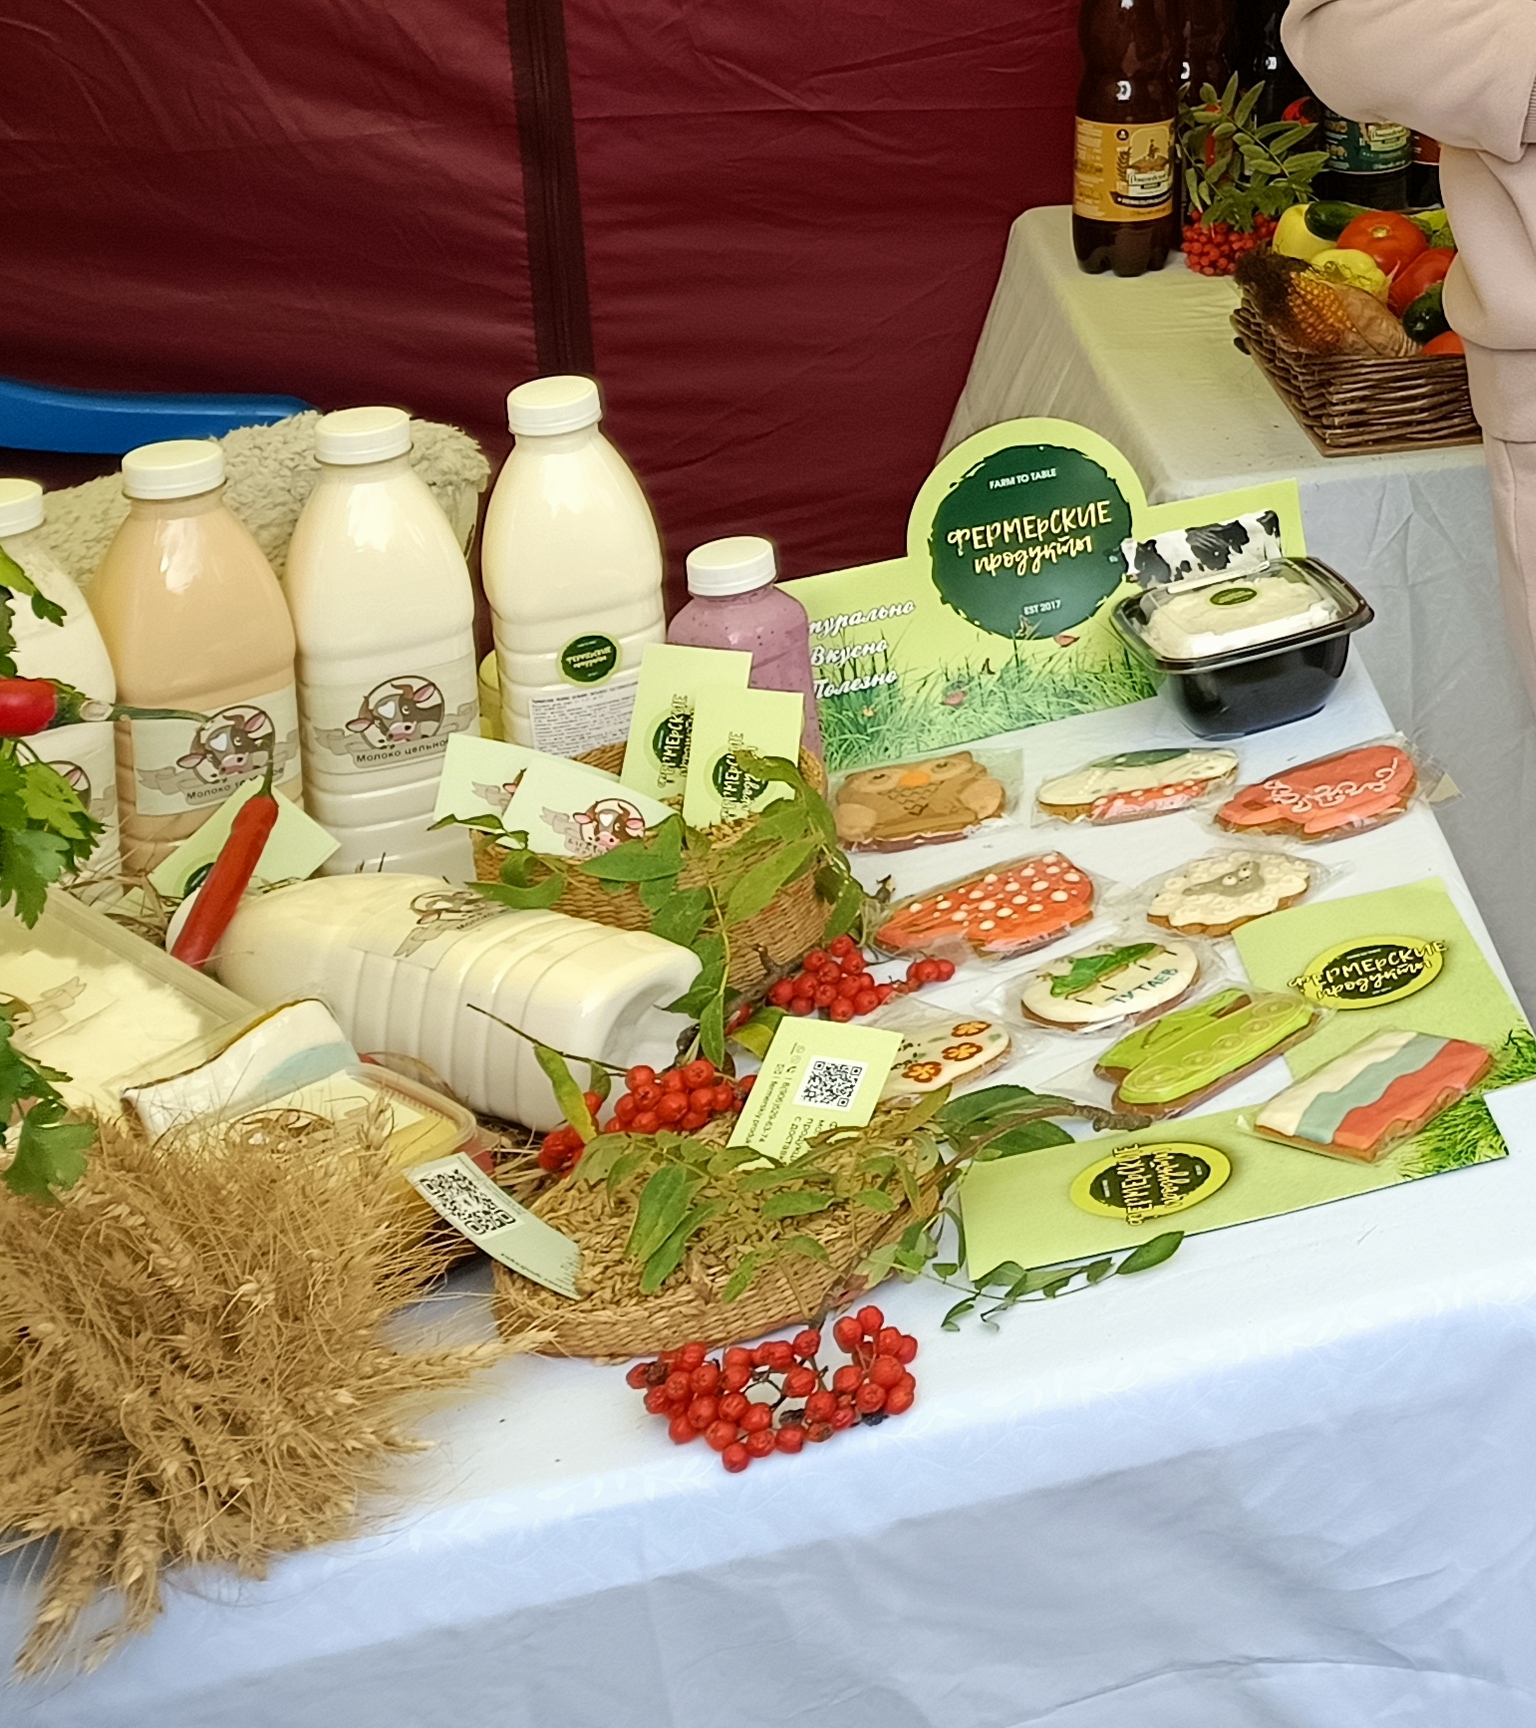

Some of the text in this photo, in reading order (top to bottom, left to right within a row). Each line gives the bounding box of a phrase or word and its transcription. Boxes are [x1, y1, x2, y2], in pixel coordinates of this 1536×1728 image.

[988, 468, 1058, 491] FARM TO TABLE
[974, 532, 1094, 577] продукты
[808, 600, 916, 638] турально
[1023, 604, 1040, 616] EST
[355, 749, 401, 763] Молоко
[186, 782, 232, 799] Молоко
